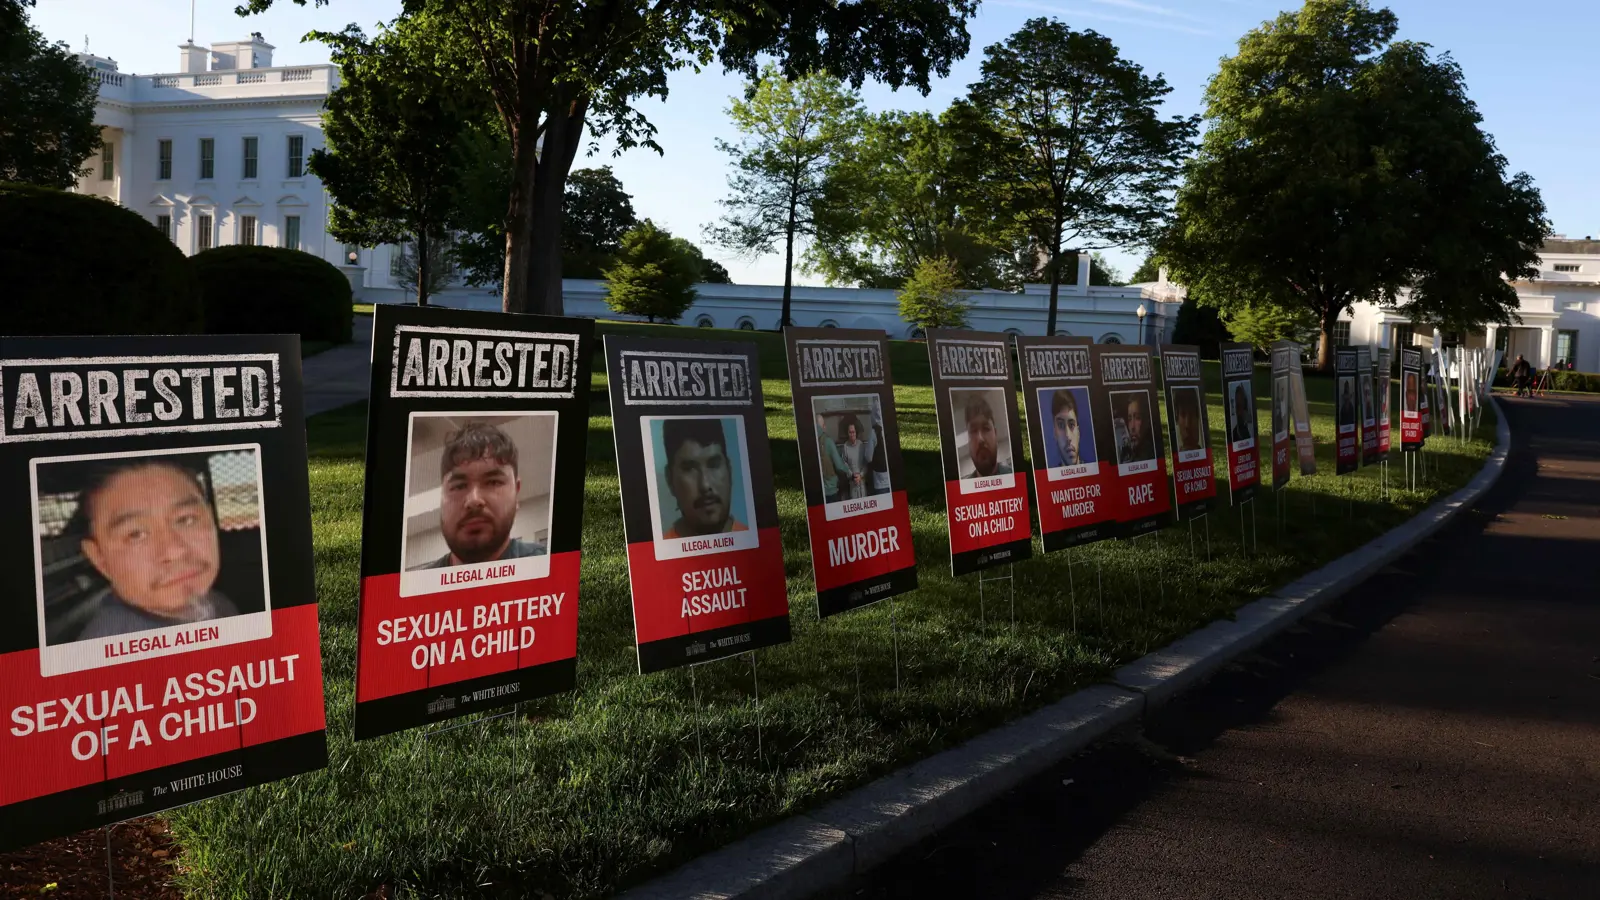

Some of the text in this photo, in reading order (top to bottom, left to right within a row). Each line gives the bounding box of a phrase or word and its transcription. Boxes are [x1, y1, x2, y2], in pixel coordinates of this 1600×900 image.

[402, 337, 571, 389] ARRESTED
[803, 346, 879, 379] ARRESTED
[941, 345, 1004, 374] ARRESTED
[1029, 350, 1089, 376] ARRESTED
[1104, 356, 1149, 380] ARRESTED
[1166, 355, 1199, 377] ARRESTED
[630, 359, 746, 397] ARRESTED
[12, 366, 268, 430] ARRESTED
[1177, 466, 1211, 481] SEXUAL ASSAULT
[1194, 480, 1207, 491] CHILD
[843, 500, 877, 513] ILLEGAL ALIEN
[1051, 484, 1101, 504] WANTED FOR
[1128, 484, 1154, 506] RAPE
[954, 497, 1024, 521] SEXUAL BATTERY
[1062, 501, 1095, 518] MURDER
[969, 516, 1014, 537] ON A CHILD
[682, 536, 734, 552] ILLEGAL ALIEN
[828, 526, 900, 567] MURDER
[440, 565, 515, 586] ILLEGAL ALIEN
[682, 566, 741, 592] SEXUAL
[681, 588, 747, 618] ASSAULT
[376, 592, 565, 646] SEXUAL BATTERY
[104, 626, 219, 658] ILLEGAL ALIEN
[411, 626, 536, 670] ON A CHILD
[717, 636, 733, 647] WHITE
[733, 632, 751, 644] HOUSE
[10, 654, 299, 737] SEXUAL ASSAULT
[461, 682, 519, 703] The WHITE HOUSE
[71, 697, 257, 761] OF A CHILD
[153, 764, 243, 796] The WHITE HOUSE
